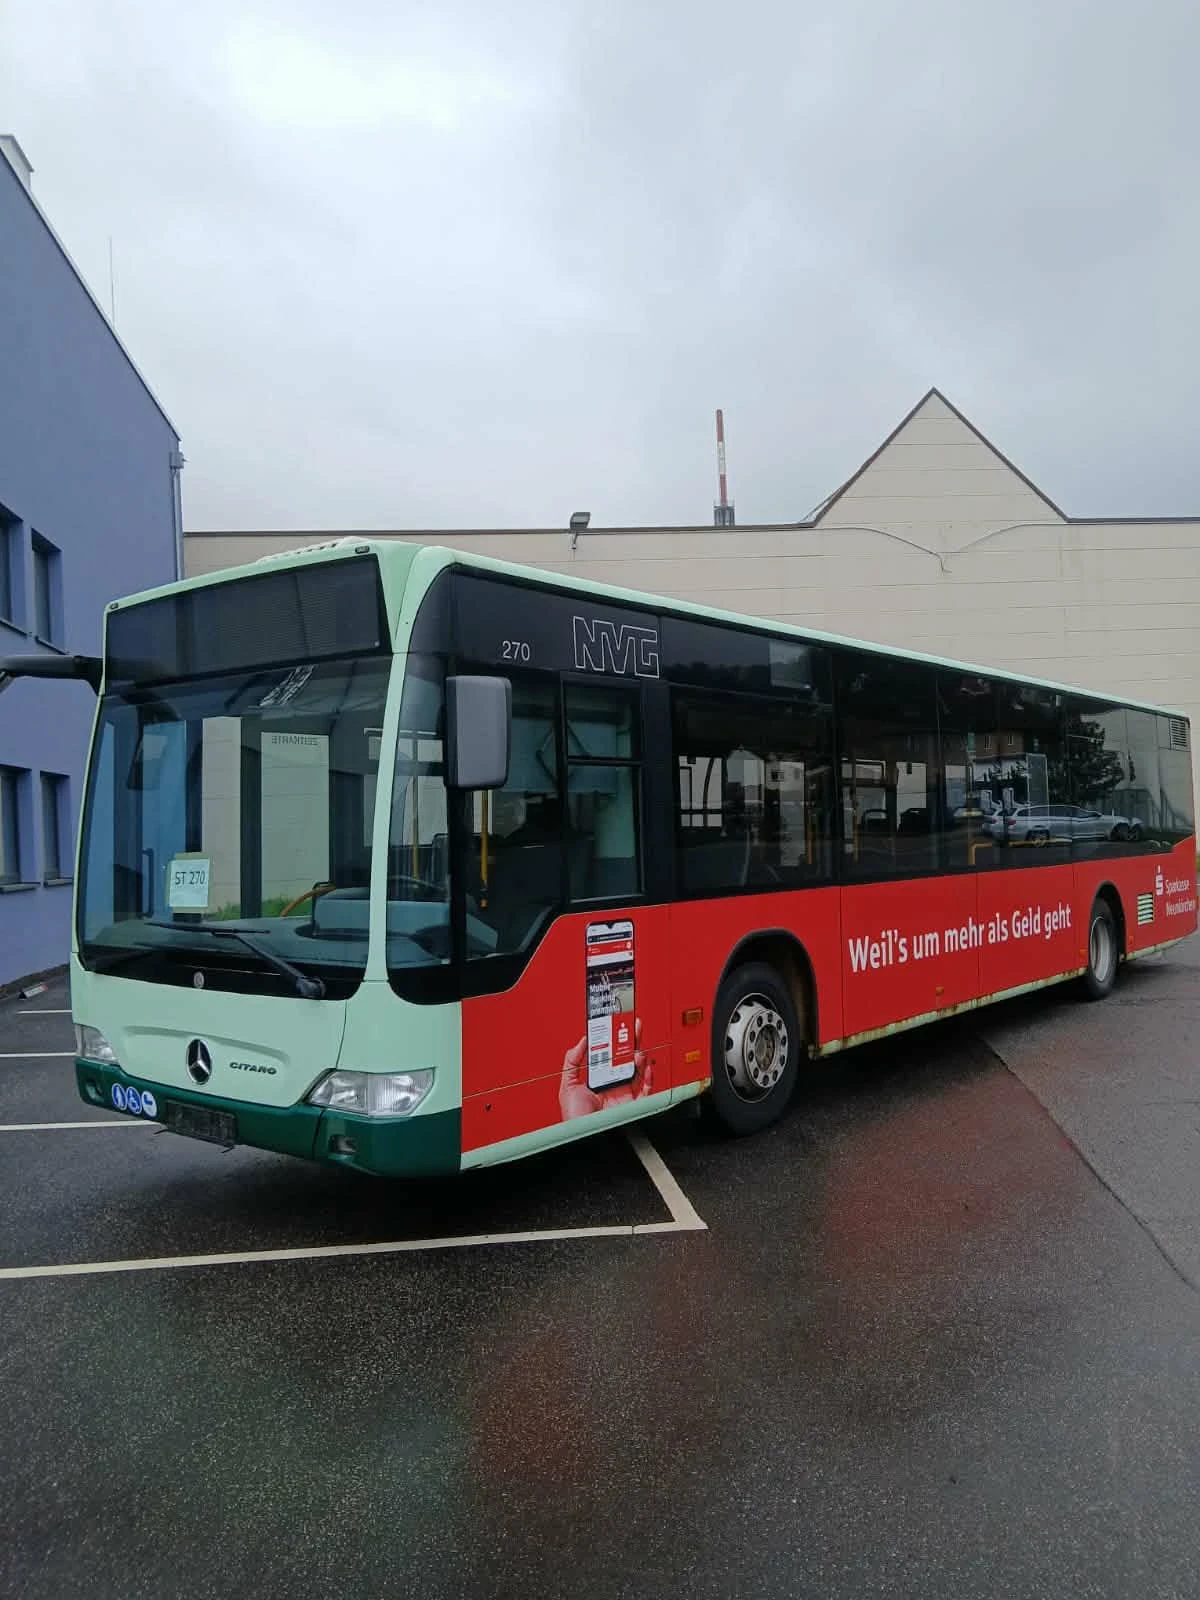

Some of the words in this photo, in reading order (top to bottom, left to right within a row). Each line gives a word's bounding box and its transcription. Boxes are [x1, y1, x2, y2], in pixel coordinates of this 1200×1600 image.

[502, 640, 530, 661] 270
[573, 615, 660, 678] NVG
[175, 871, 186, 885] ST
[189, 870, 206, 885] 270
[1165, 878, 1190, 896] Sparkasse
[848, 929, 908, 973] Weil's
[913, 932, 940, 960] um
[944, 916, 985, 953] mehr
[988, 912, 1009, 944] als
[1011, 905, 1041, 938] Geld
[1044, 901, 1071, 940] geht
[229, 1061, 277, 1076] CITARO
